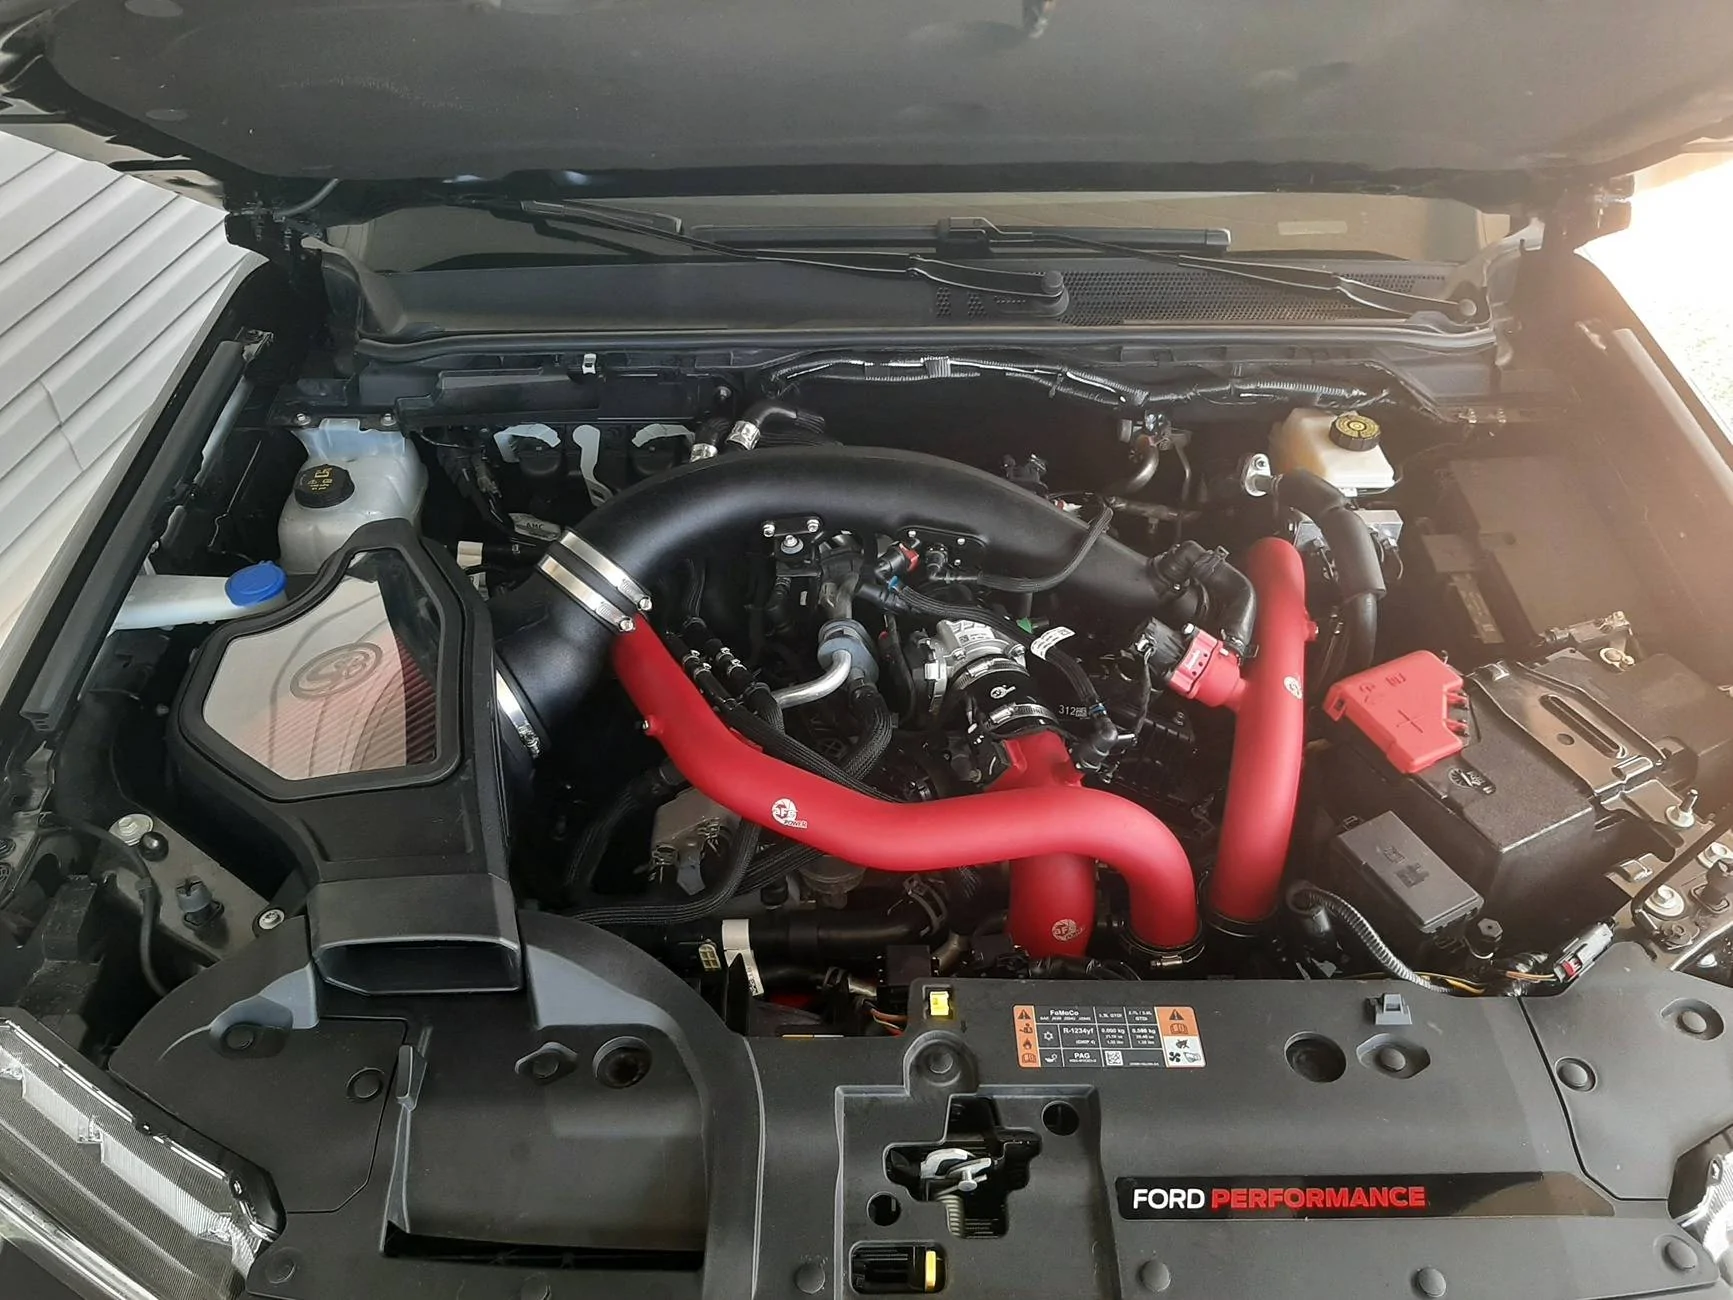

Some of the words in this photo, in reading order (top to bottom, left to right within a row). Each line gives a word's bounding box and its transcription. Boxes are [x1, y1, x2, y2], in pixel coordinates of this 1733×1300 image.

[783, 819, 807, 829] POWER
[1063, 1027, 1094, 1035] R-1234yf
[1132, 1188, 1206, 1210] FORD
[1211, 1186, 1426, 1210] PERFORMANCE
